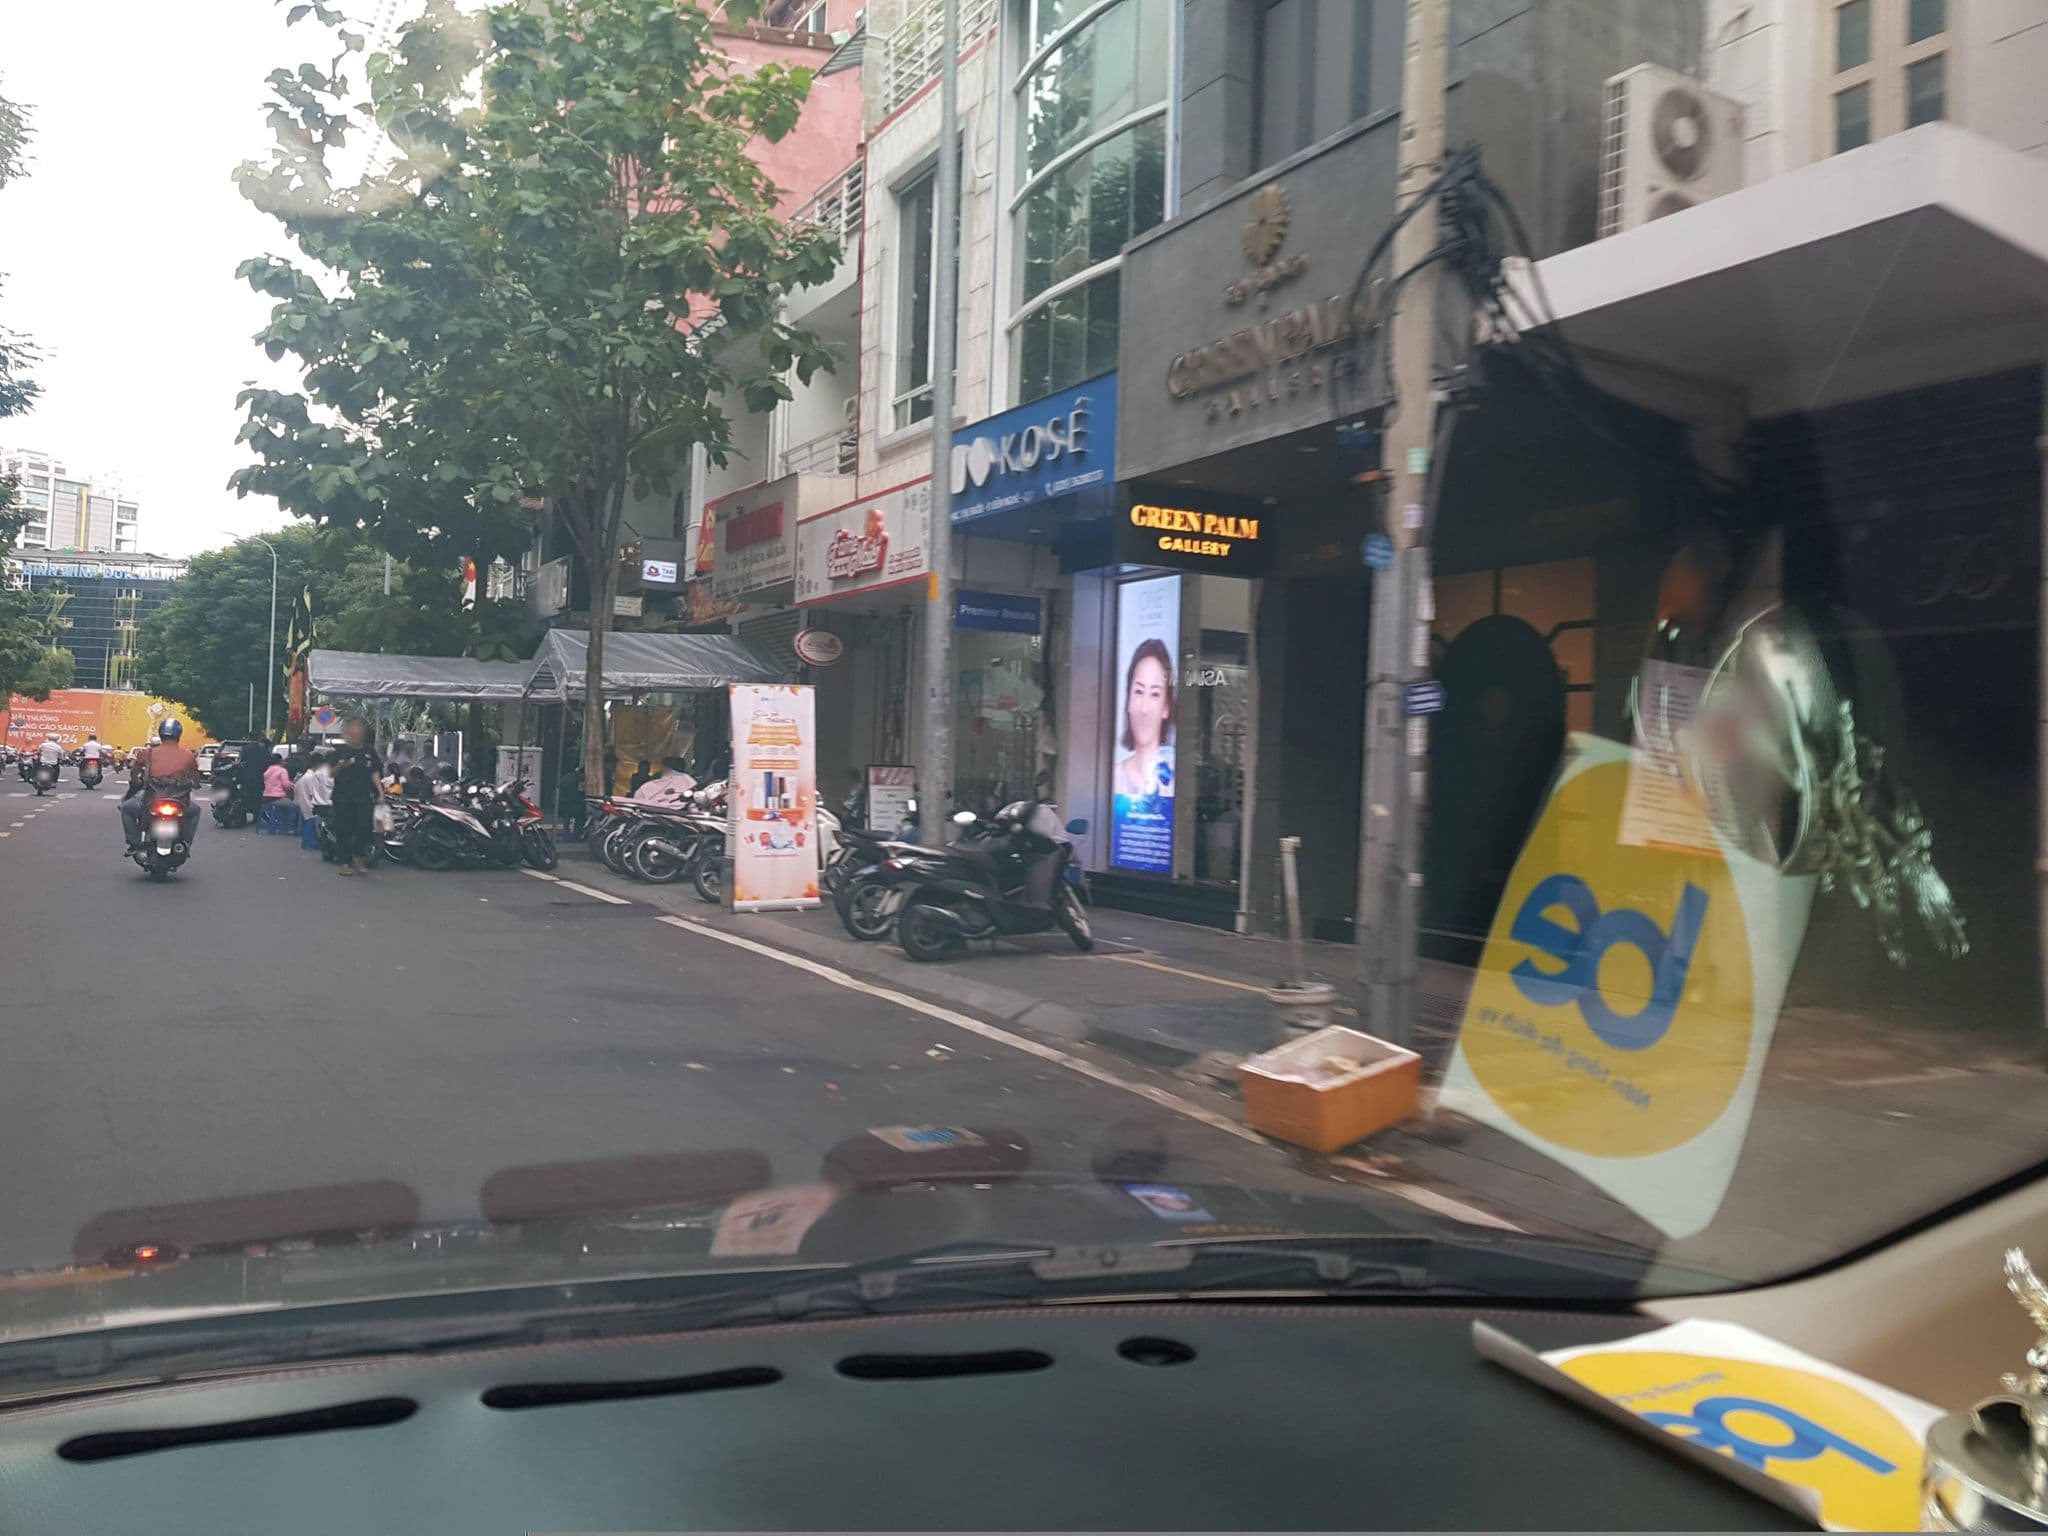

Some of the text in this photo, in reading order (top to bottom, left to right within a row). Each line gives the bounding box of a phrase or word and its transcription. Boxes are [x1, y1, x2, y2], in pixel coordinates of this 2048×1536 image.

[1130, 504, 1259, 539] GREEN PALM
[1158, 536, 1231, 556] GALLERY
